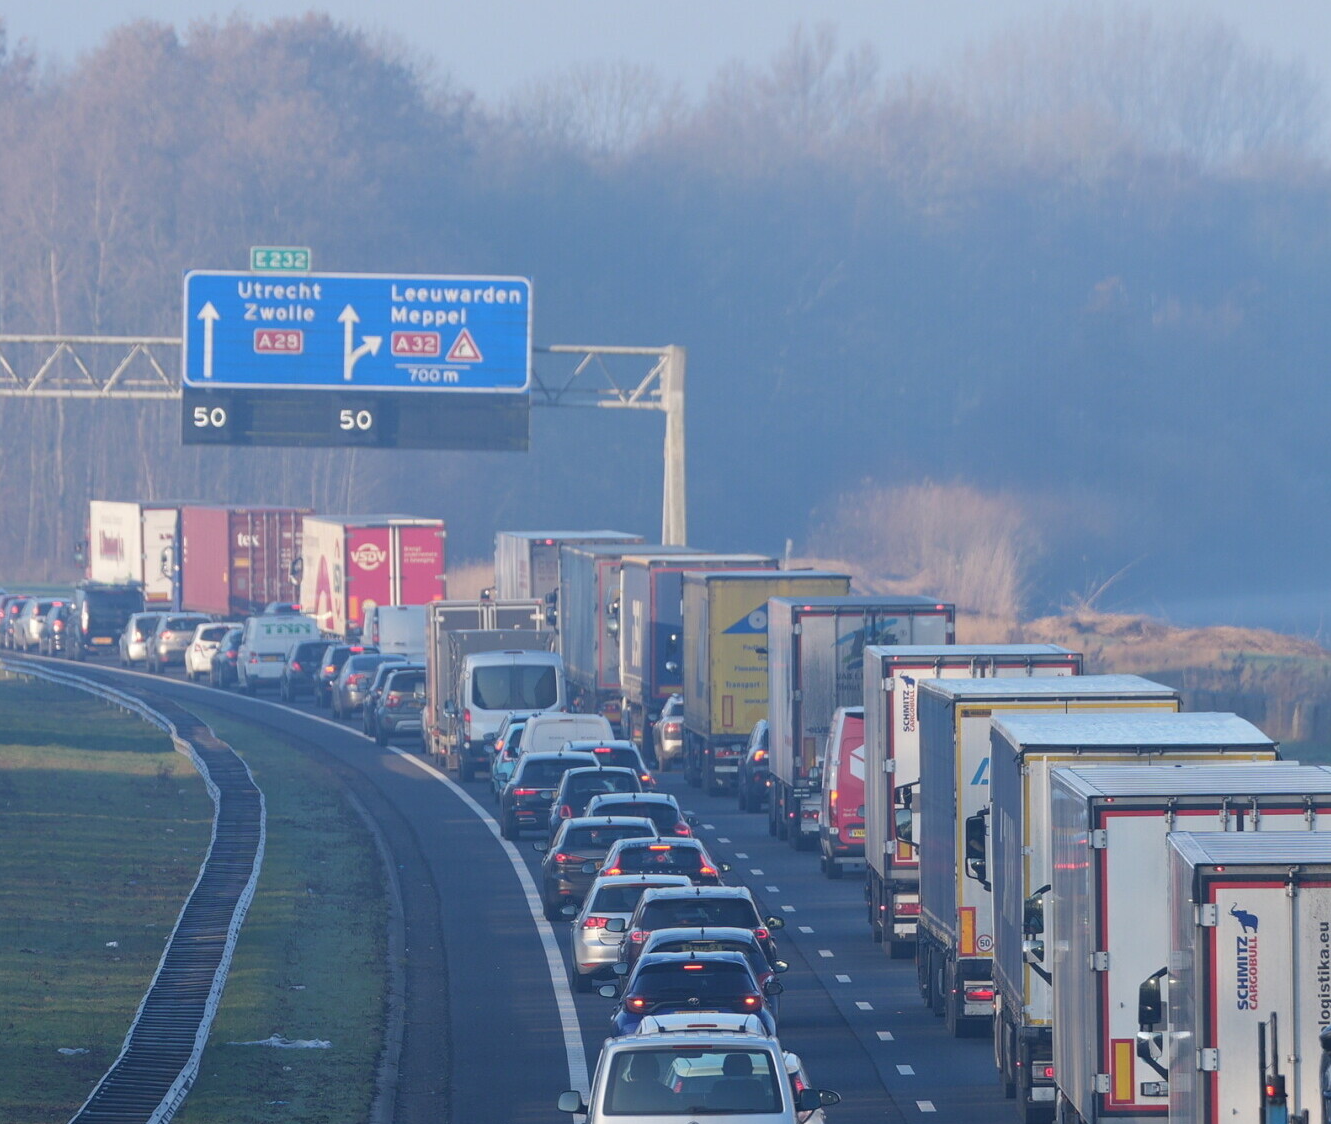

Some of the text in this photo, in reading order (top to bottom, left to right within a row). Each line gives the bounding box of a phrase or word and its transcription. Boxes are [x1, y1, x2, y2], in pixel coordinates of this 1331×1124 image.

[256, 251, 307, 269] E 232
[237, 281, 321, 300] Utrecht
[391, 285, 521, 304] Leeuwarden
[244, 304, 315, 322] Zwolle
[391, 306, 467, 326] Meppel
[395, 337, 436, 354] A32
[407, 368, 459, 384] 700 m
[193, 407, 227, 428] 50
[339, 410, 373, 431] 50
[237, 532, 259, 547] tex
[1237, 936, 1249, 1010] SCHMITZ
[1249, 936, 1258, 1010] CARGOBULL
